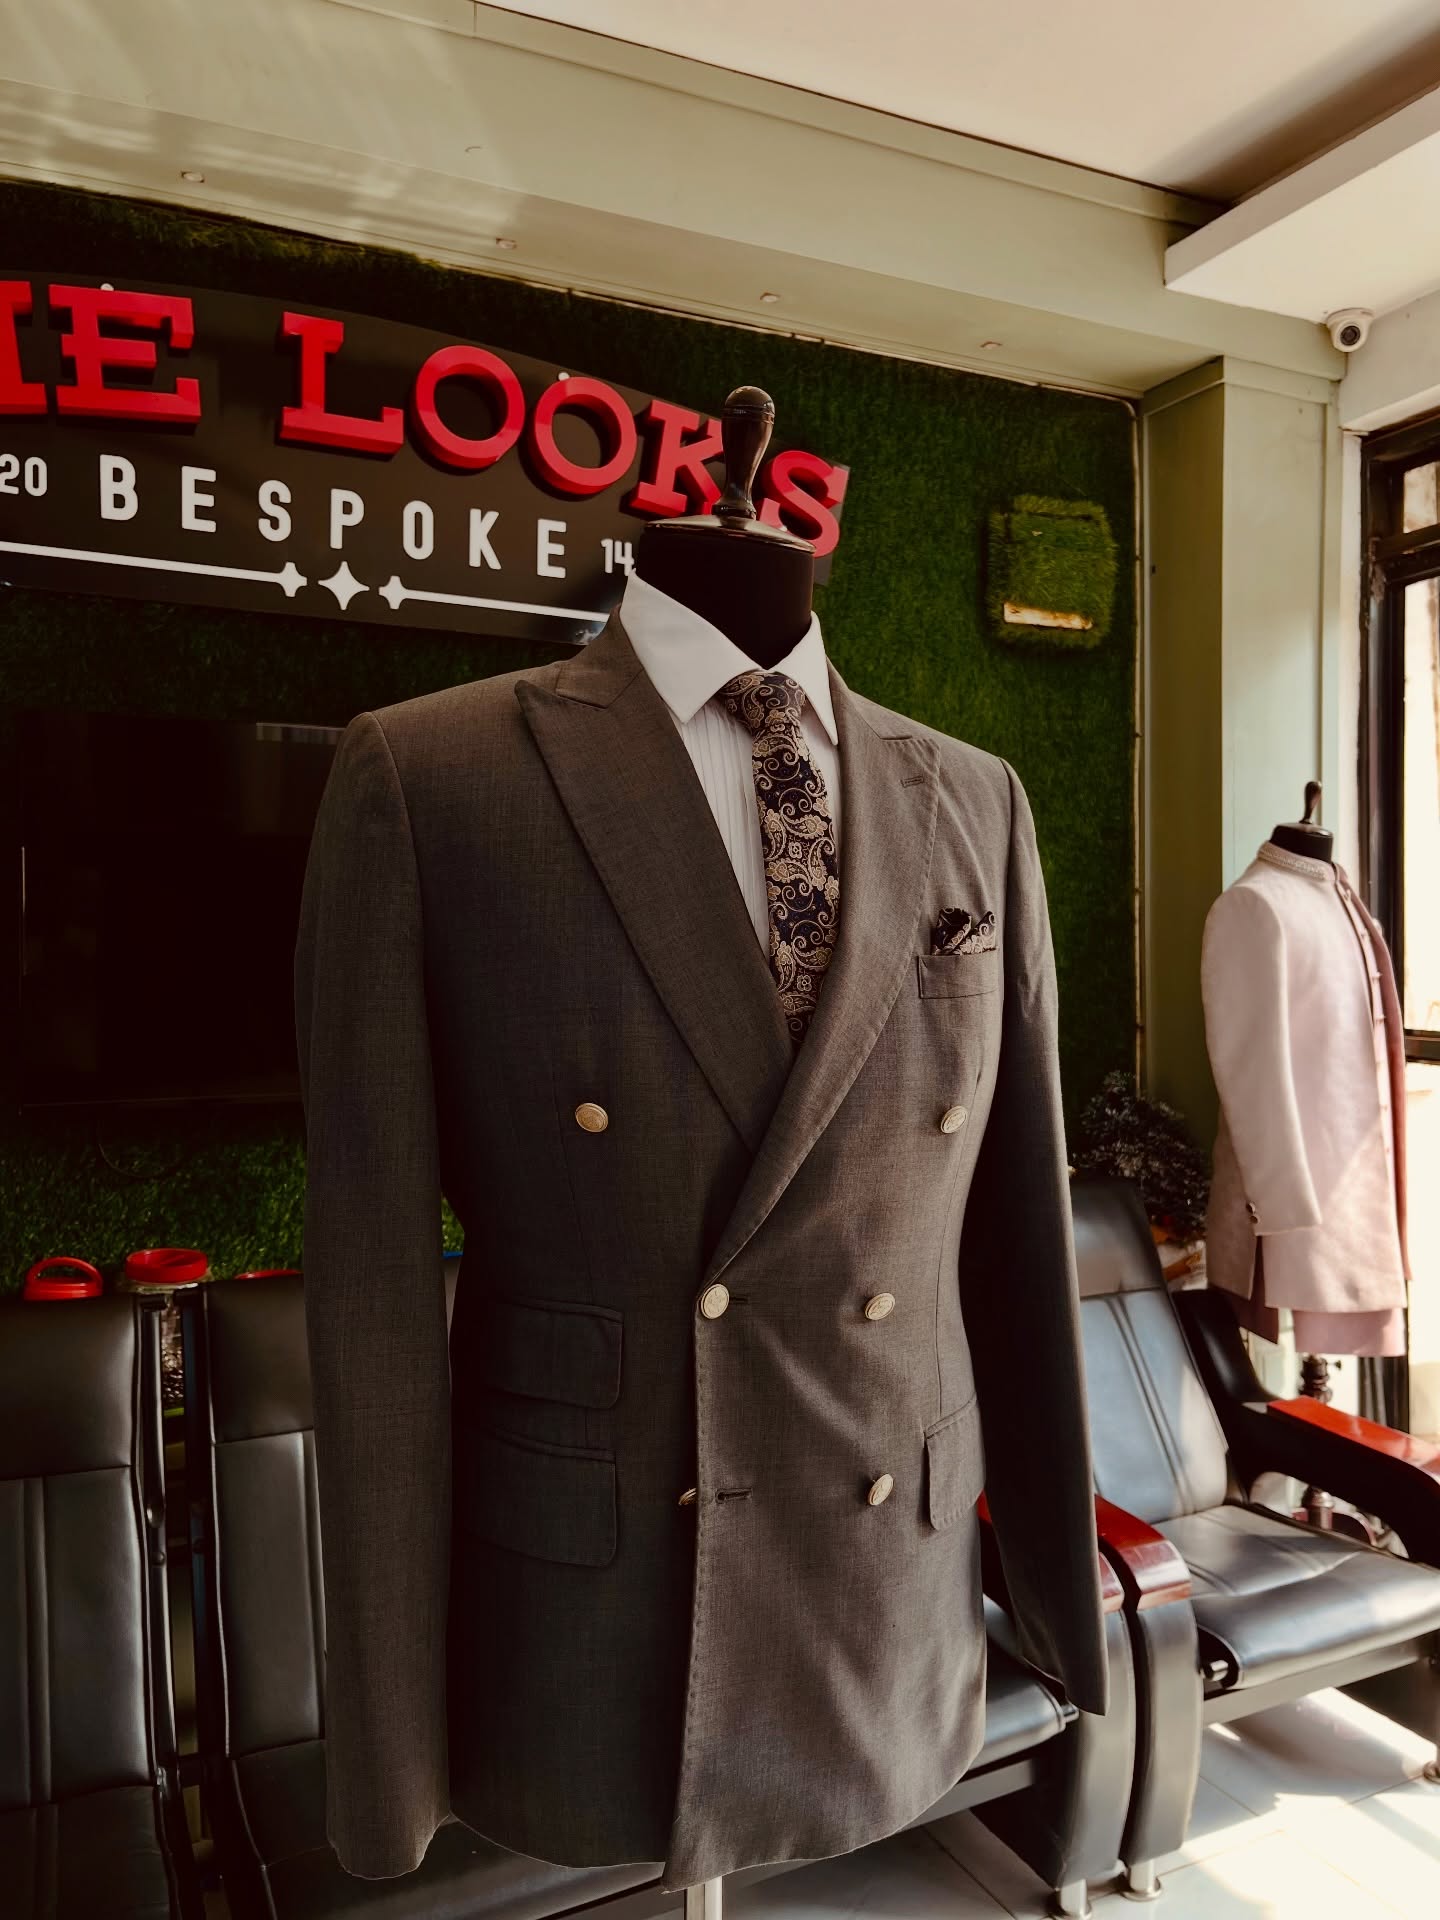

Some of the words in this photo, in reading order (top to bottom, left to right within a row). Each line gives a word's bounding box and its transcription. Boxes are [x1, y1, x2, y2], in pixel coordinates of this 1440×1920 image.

[0, 453, 48, 497] 20
[99, 454, 568, 579] BESPOKE
[600, 538, 635, 577] 14
[280, 311, 850, 559] LOOKS
